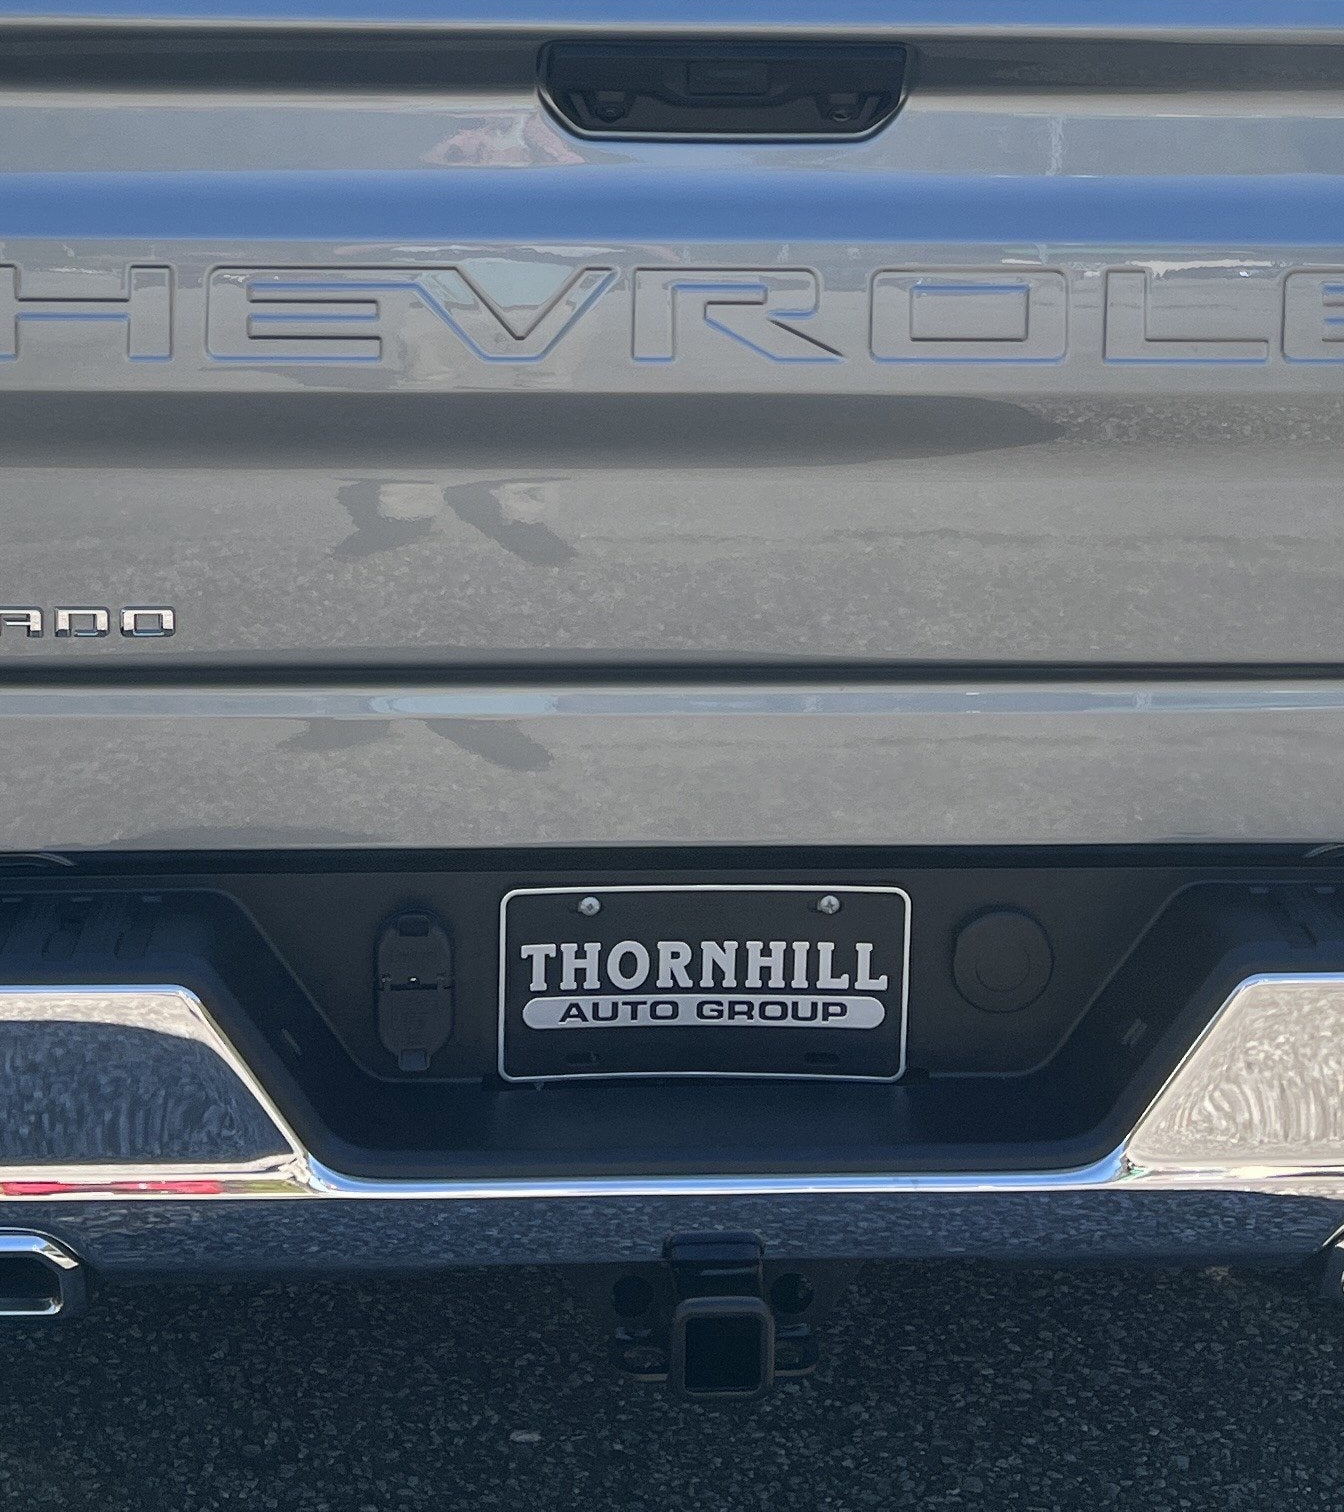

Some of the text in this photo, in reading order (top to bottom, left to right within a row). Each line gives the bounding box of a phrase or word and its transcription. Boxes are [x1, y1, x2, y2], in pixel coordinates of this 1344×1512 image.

[520, 940, 889, 992] THORNHILL
[558, 1000, 849, 1023] AUTO GROUP
